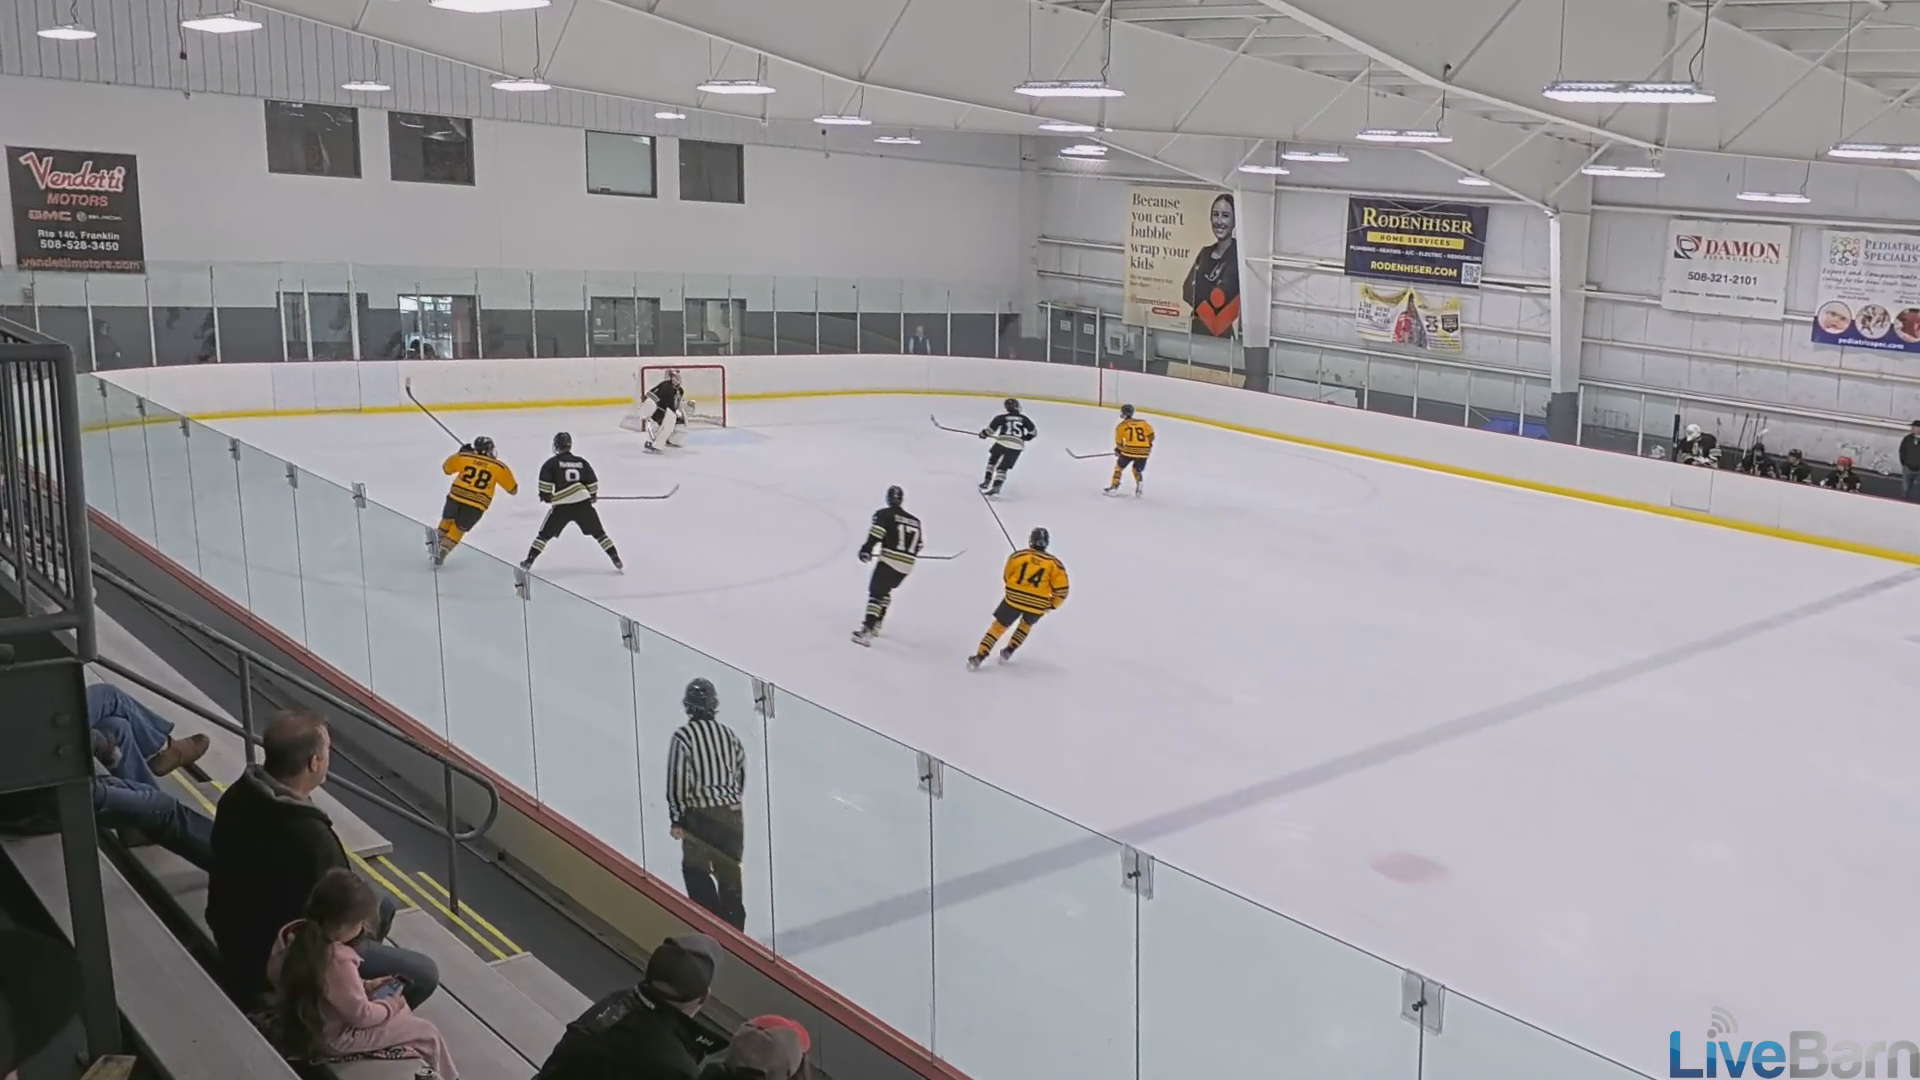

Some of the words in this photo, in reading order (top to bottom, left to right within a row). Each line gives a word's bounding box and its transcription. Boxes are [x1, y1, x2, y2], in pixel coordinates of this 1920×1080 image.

[18, 151, 126, 192] Vendetti
[47, 192, 109, 207] MOTORS
[1131, 193, 1181, 209] Because
[28, 209, 72, 221] GMC
[1131, 210, 1153, 223] you
[1155, 211, 1185, 226] can't
[37, 229, 55, 239] Rte
[58, 231, 78, 240] 140,
[80, 231, 120, 241] Franklin
[1130, 222, 1172, 241] bubble
[40, 238, 119, 252] 508-528-3450
[1380, 235, 1404, 244] HOME
[1407, 236, 1451, 247] SERVICES
[1705, 239, 1781, 259] DAMON
[1130, 242, 1160, 258] wrap
[1162, 245, 1191, 260] your
[20, 257, 141, 271] vendettimotors.com
[1130, 255, 1155, 270] kids
[1370, 261, 1458, 278] RODENHISER.COM
[1688, 271, 1758, 286] 508-321-2101
[1006, 421, 1024, 437] 15
[1124, 427, 1146, 442] 78
[461, 466, 493, 490] 28
[896, 523, 921, 554] 17
[1016, 561, 1046, 588] 14
